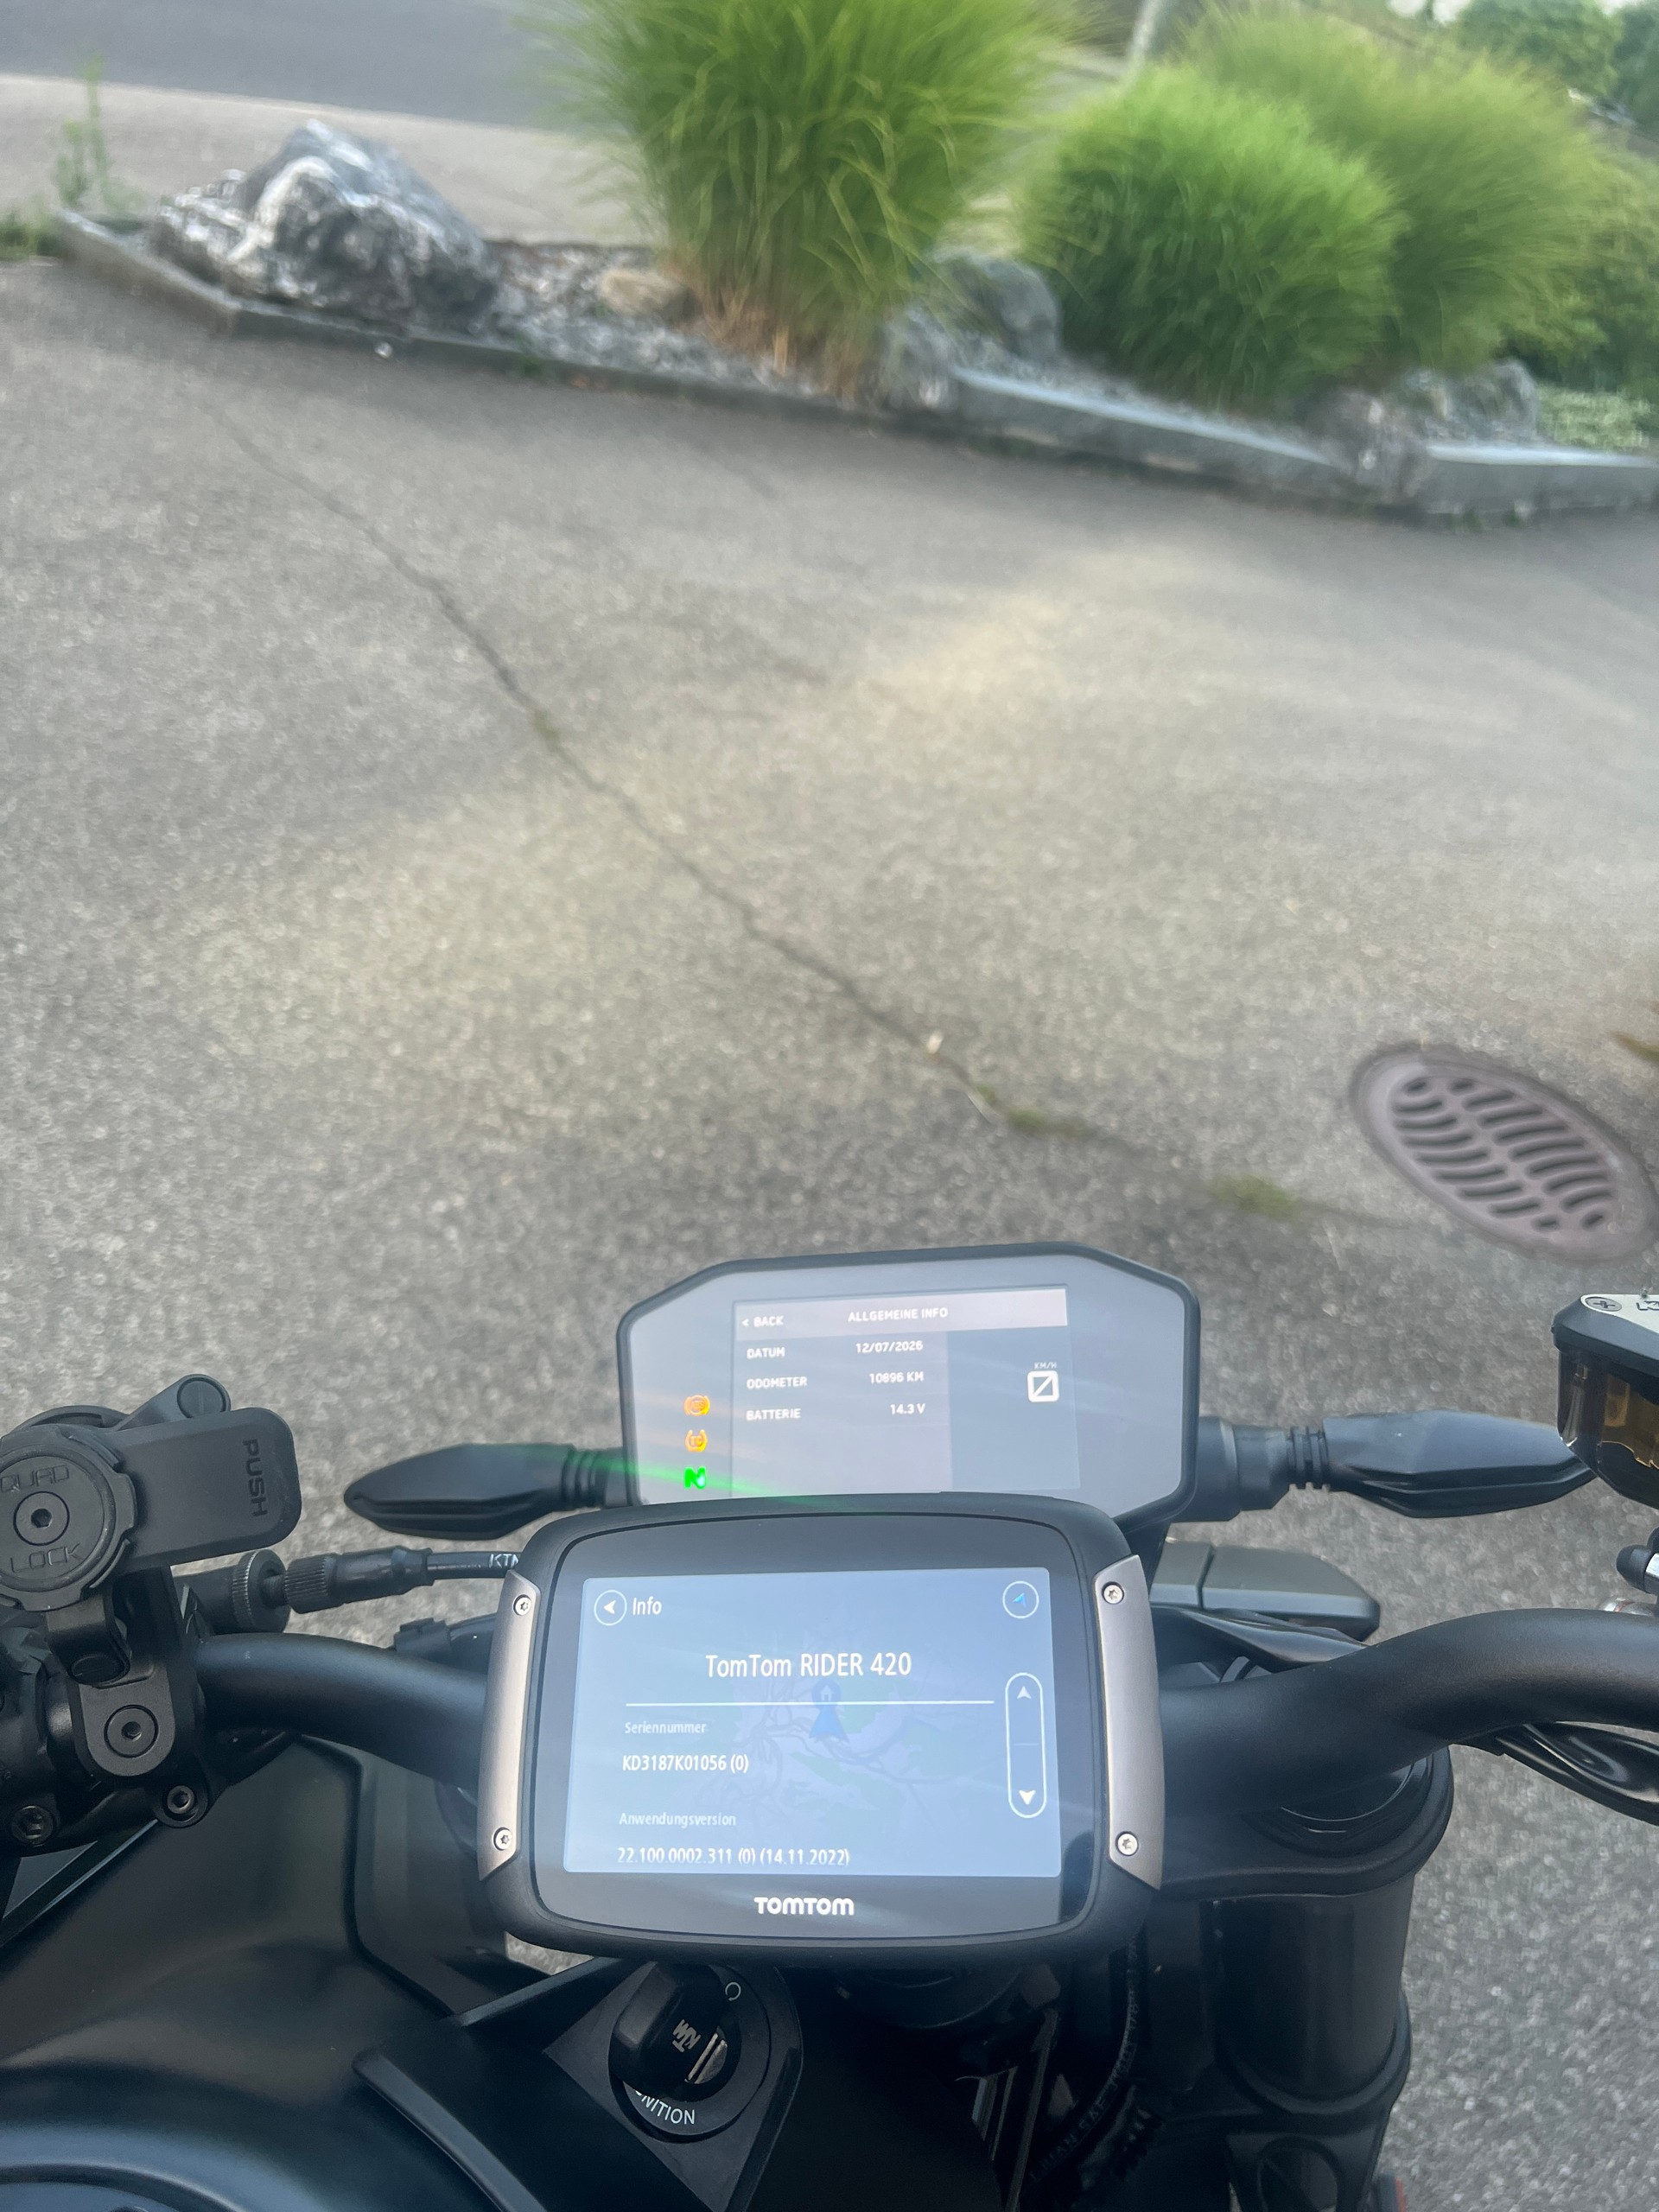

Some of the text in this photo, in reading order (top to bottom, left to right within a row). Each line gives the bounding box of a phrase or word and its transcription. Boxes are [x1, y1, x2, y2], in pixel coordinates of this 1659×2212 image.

[753, 1315, 785, 1328] BACK
[848, 1306, 950, 1323] ALLGEMEINE INFO
[746, 1346, 786, 1360] DATUM
[855, 1340, 925, 1355] 12/07/2026
[746, 1376, 809, 1389] ODOMETER
[906, 1370, 925, 1383] KM
[746, 1408, 802, 1421] BATTERIE
[890, 1402, 926, 1415] 14.3 V
[0, 1465, 70, 1493] QUAD
[243, 1438, 268, 1517] PUSH
[10, 1542, 81, 1573] LOCK
[632, 1596, 663, 1616] Info
[705, 1651, 912, 1678] TomTom RIDER 420
[624, 1720, 708, 1735] Seriennummer
[622, 1753, 750, 1774] KD3187K01056 (0)
[618, 1811, 737, 1829] Anwendungsversion
[617, 1847, 851, 1867] 22.100.0002.311 (0) (14.11.2022)
[635, 2089, 696, 2126] NITION
